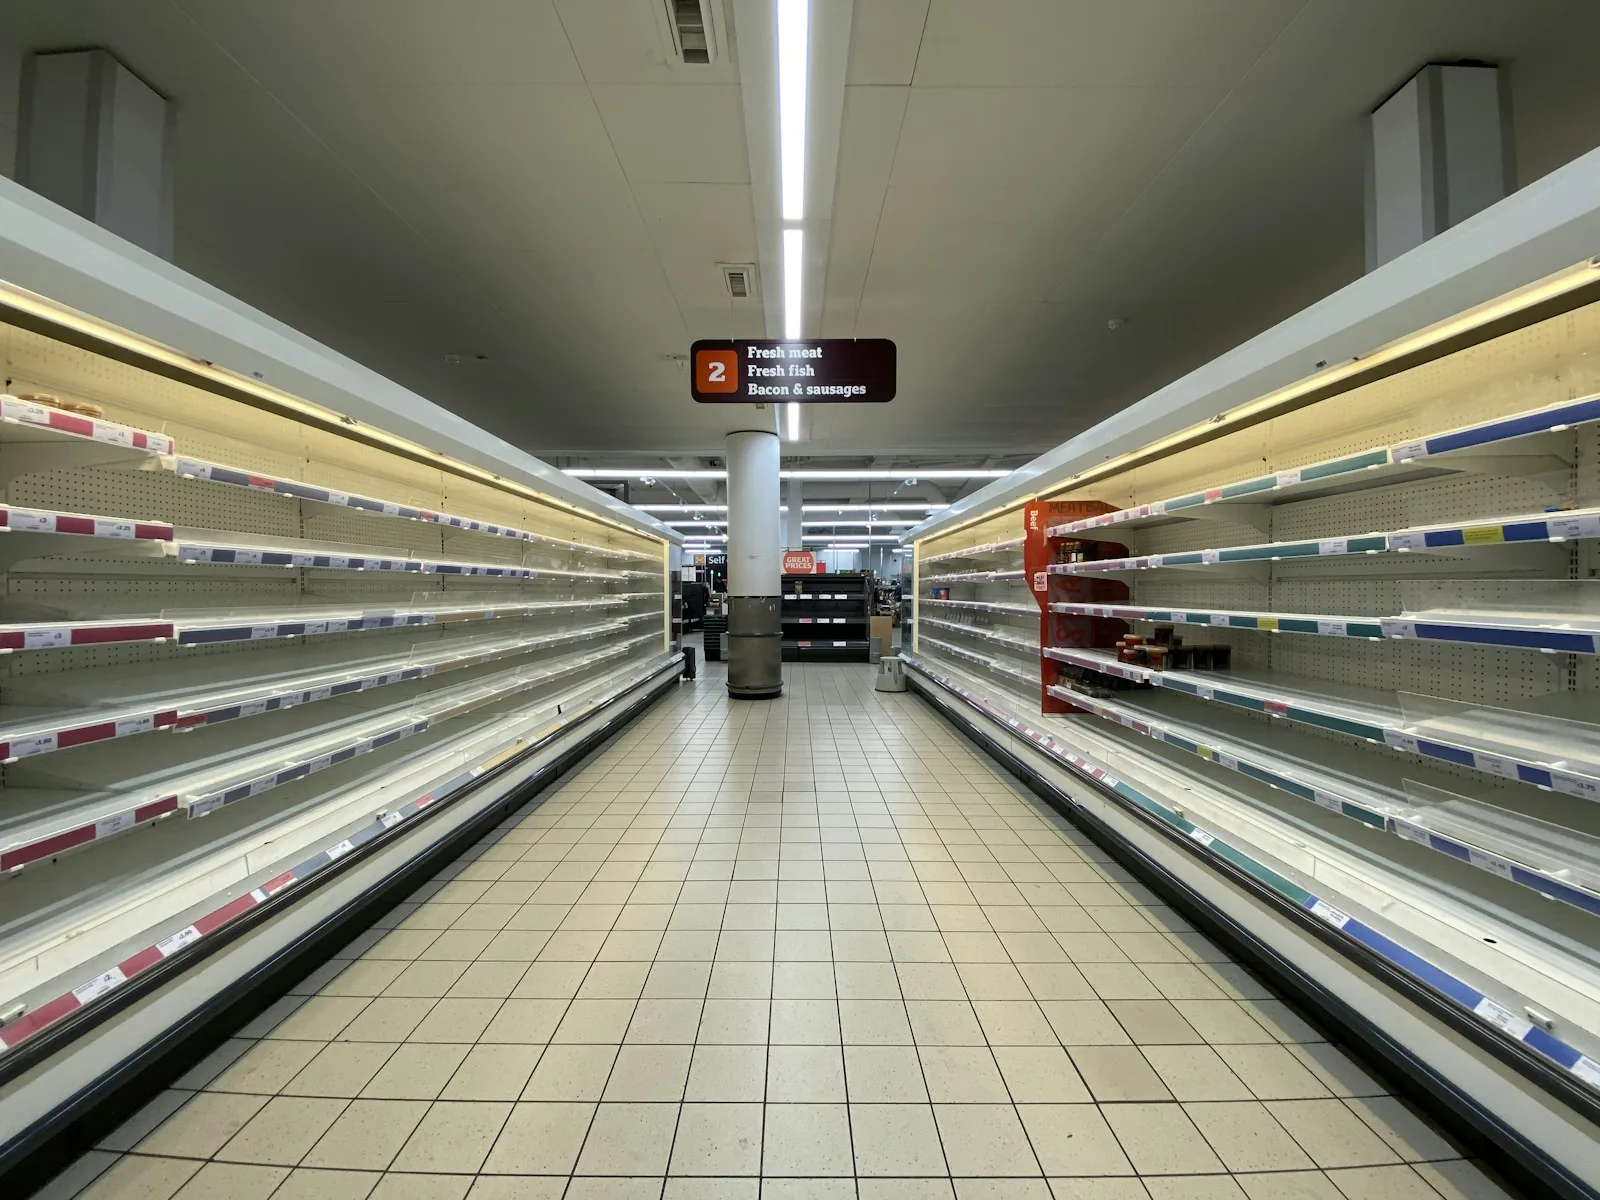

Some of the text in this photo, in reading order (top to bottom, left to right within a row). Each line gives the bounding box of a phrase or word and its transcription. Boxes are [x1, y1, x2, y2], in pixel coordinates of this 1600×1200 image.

[747, 346, 823, 359] Fresh meat
[708, 361, 726, 382] 2
[747, 365, 815, 377] Fresh fish
[747, 383, 867, 398] Bacon & sausages
[1030, 510, 1039, 531] Beef
[708, 556, 726, 565] Self
